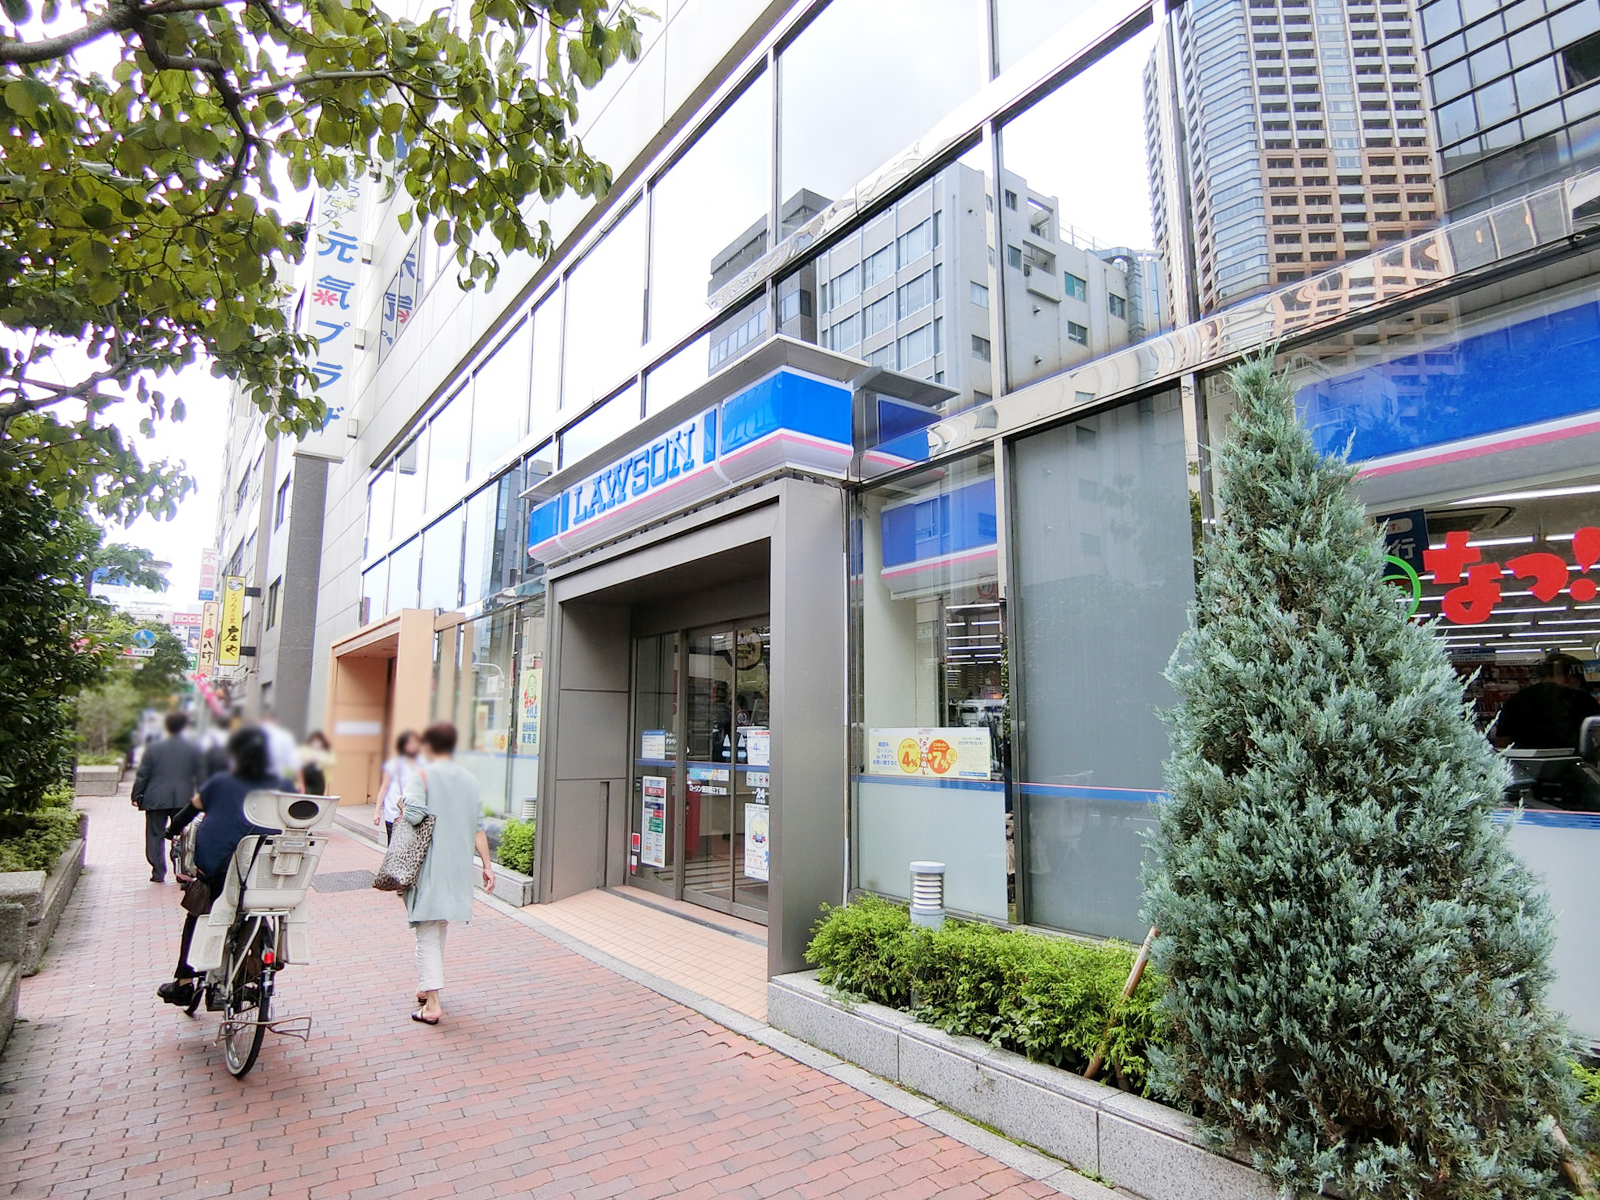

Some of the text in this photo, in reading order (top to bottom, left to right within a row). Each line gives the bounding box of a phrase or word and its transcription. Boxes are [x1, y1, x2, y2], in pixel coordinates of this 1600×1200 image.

[573, 423, 695, 524] LAWSON
[223, 625, 239, 656] 庄や
[902, 751, 918, 767] 4%
[932, 751, 949, 769] 7%
